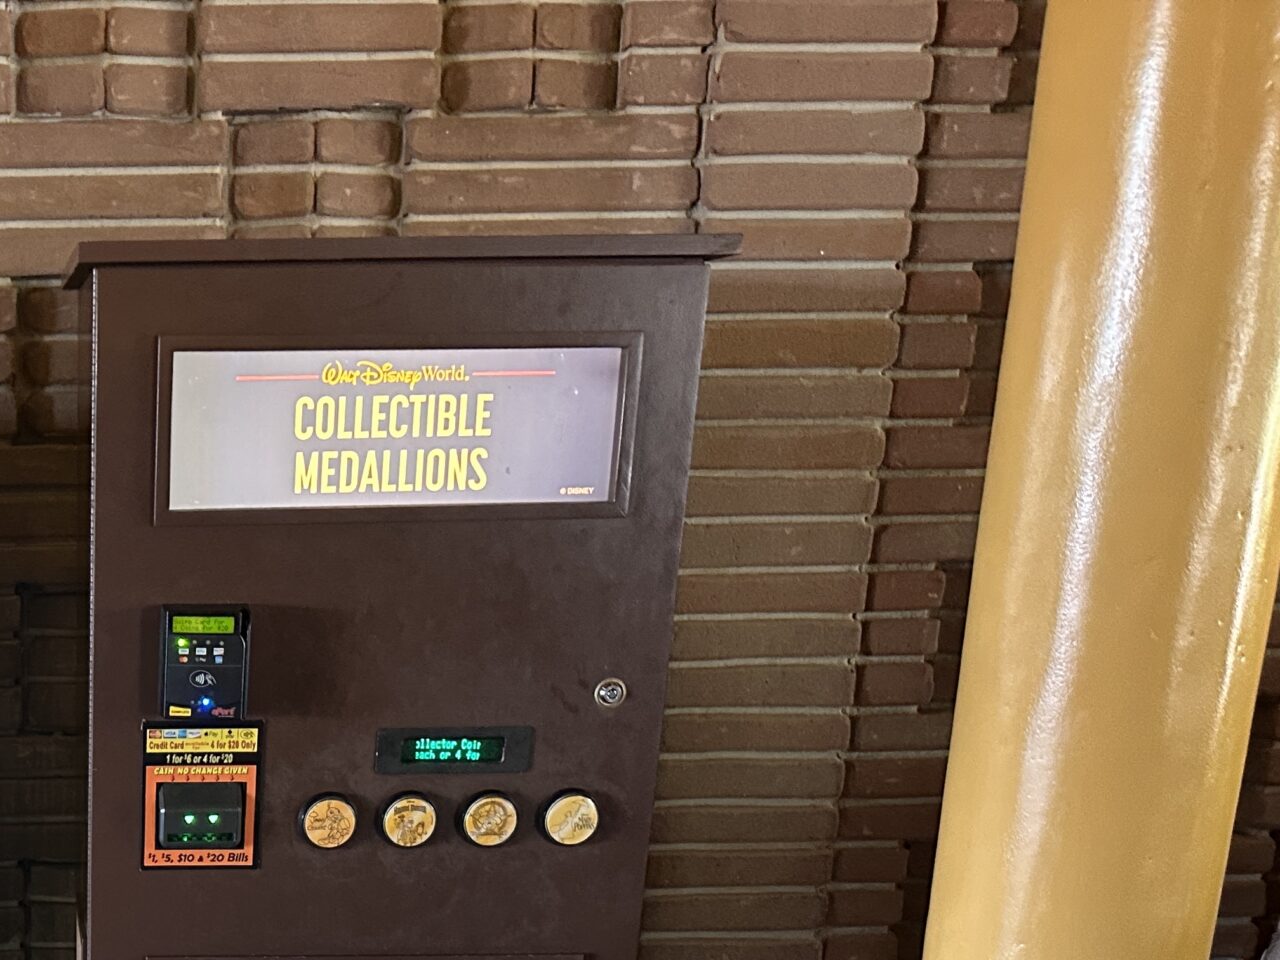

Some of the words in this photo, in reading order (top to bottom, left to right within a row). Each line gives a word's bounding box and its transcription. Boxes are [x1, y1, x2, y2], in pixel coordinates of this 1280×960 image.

[322, 360, 360, 386] Walt
[357, 360, 421, 391] Disney
[294, 393, 494, 440] COLLECTIBLE
[294, 448, 489, 494] MEDALLIONS
[567, 487, 594, 495] DISNEY
[149, 741, 168, 750] Credit
[170, 741, 184, 750] Card
[216, 740, 226, 749] for
[241, 740, 256, 751] Only
[166, 754, 170, 763] 1
[172, 753, 183, 764] for
[184, 753, 192, 763] $6
[202, 754, 207, 763] 4
[209, 753, 220, 764] for
[221, 753, 233, 763] $20
[440, 751, 451, 760] or
[455, 750, 461, 760] 4
[224, 766, 248, 774] GIVEN
[177, 853, 194, 863] $10
[207, 853, 224, 863] $20
[228, 853, 249, 863] Bills
